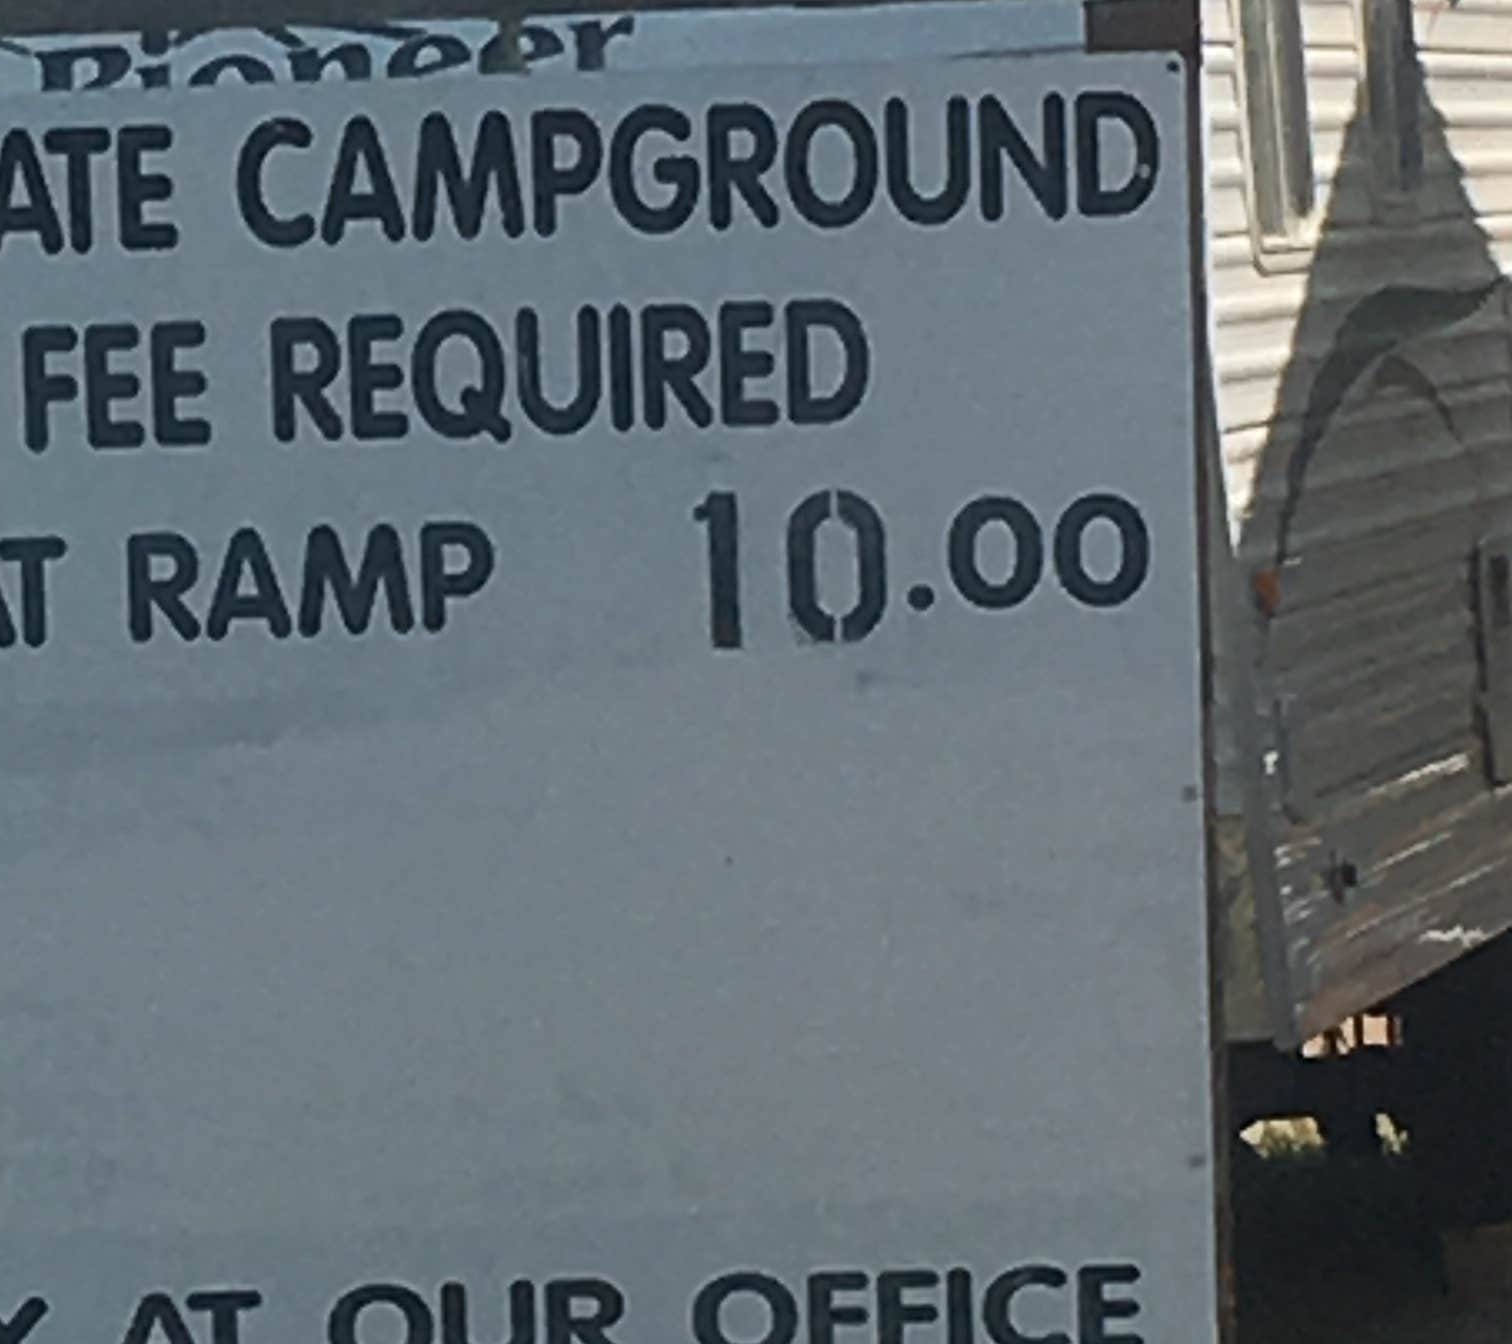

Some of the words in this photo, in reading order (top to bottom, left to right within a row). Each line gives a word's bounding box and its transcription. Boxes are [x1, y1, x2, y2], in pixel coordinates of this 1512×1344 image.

[236, 91, 1160, 249] CAMPGROUND
[21, 320, 212, 454] FEE
[270, 298, 869, 444] REQUIRED
[126, 521, 495, 643] RAMP
[693, 489, 1150, 650] 10.00
